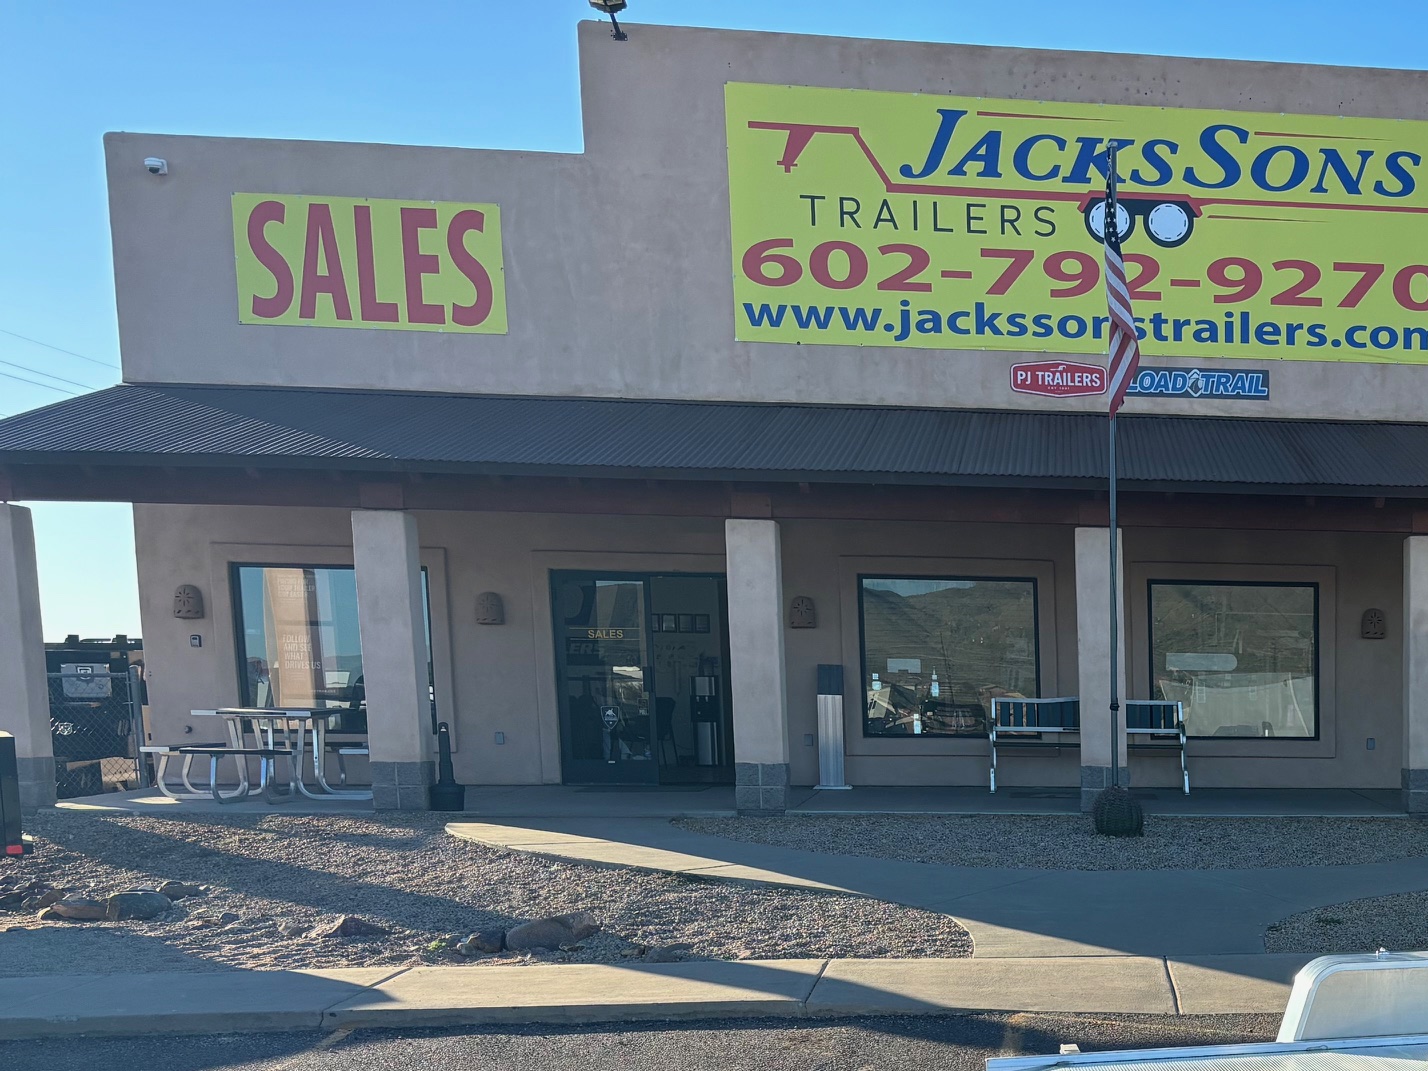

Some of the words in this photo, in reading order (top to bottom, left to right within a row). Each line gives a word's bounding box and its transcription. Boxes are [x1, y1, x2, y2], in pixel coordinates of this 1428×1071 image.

[799, 194, 1057, 238] TRAILERS
[247, 200, 494, 327] SALES
[1017, 371, 1031, 385] PJ
[1035, 371, 1101, 387] TRAILERS
[1200, 372, 1268, 396] TRAIL
[282, 634, 310, 643] FOLLOW
[587, 630, 623, 639] SALES
[283, 643, 298, 652] AND
[284, 652, 304, 660] WHAT
[284, 660, 310, 669] DRIVES
[311, 661, 321, 669] US
